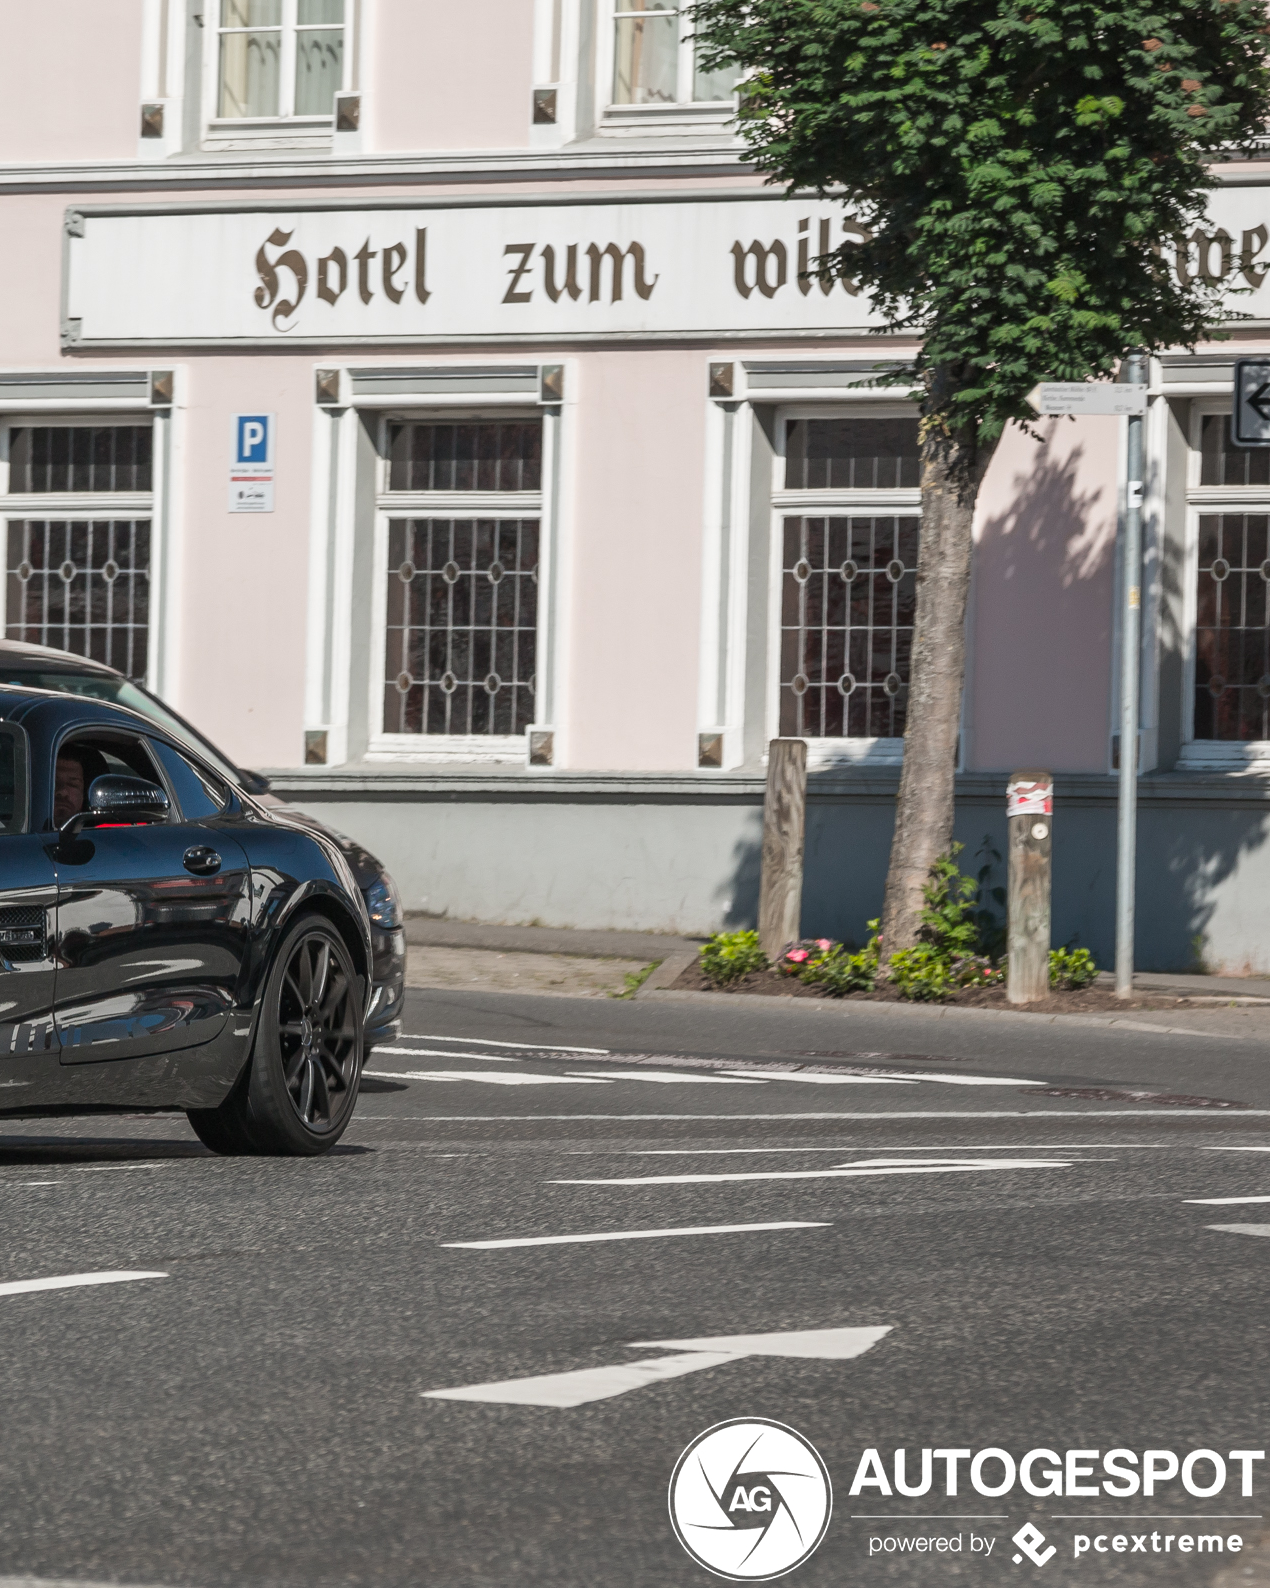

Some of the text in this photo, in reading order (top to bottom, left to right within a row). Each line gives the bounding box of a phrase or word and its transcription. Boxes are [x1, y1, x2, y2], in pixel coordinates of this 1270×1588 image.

[253, 226, 432, 332] Hotel
[500, 241, 660, 306] zum
[242, 421, 264, 457] P
